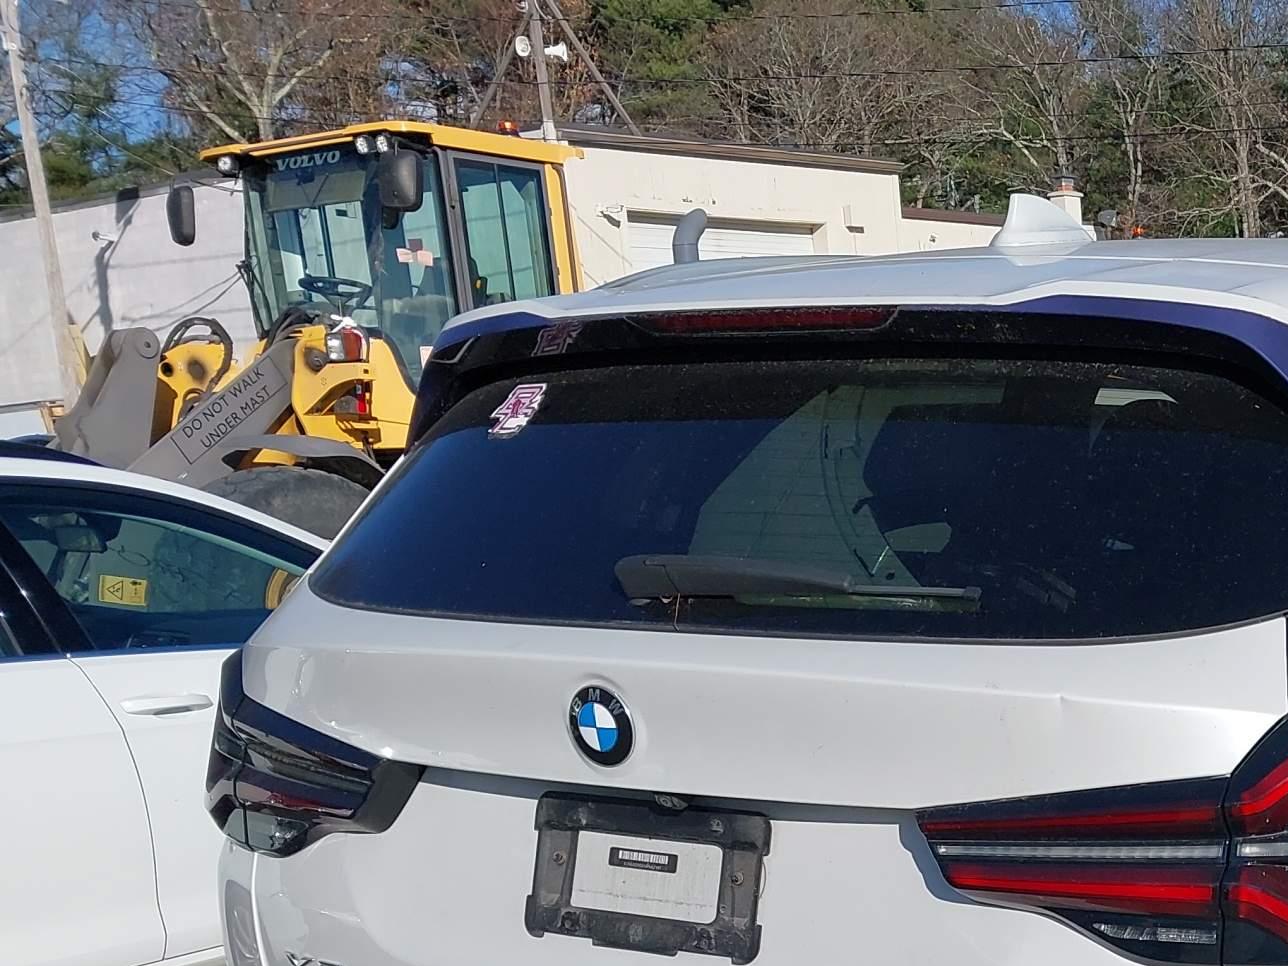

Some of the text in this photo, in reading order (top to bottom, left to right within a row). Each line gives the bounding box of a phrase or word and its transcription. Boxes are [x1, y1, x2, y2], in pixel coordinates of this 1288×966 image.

[276, 150, 340, 171] VOLVO
[182, 367, 265, 439] DO NOT WALK
[200, 385, 272, 448] UNDER MAST
[571, 687, 625, 717] BMW
